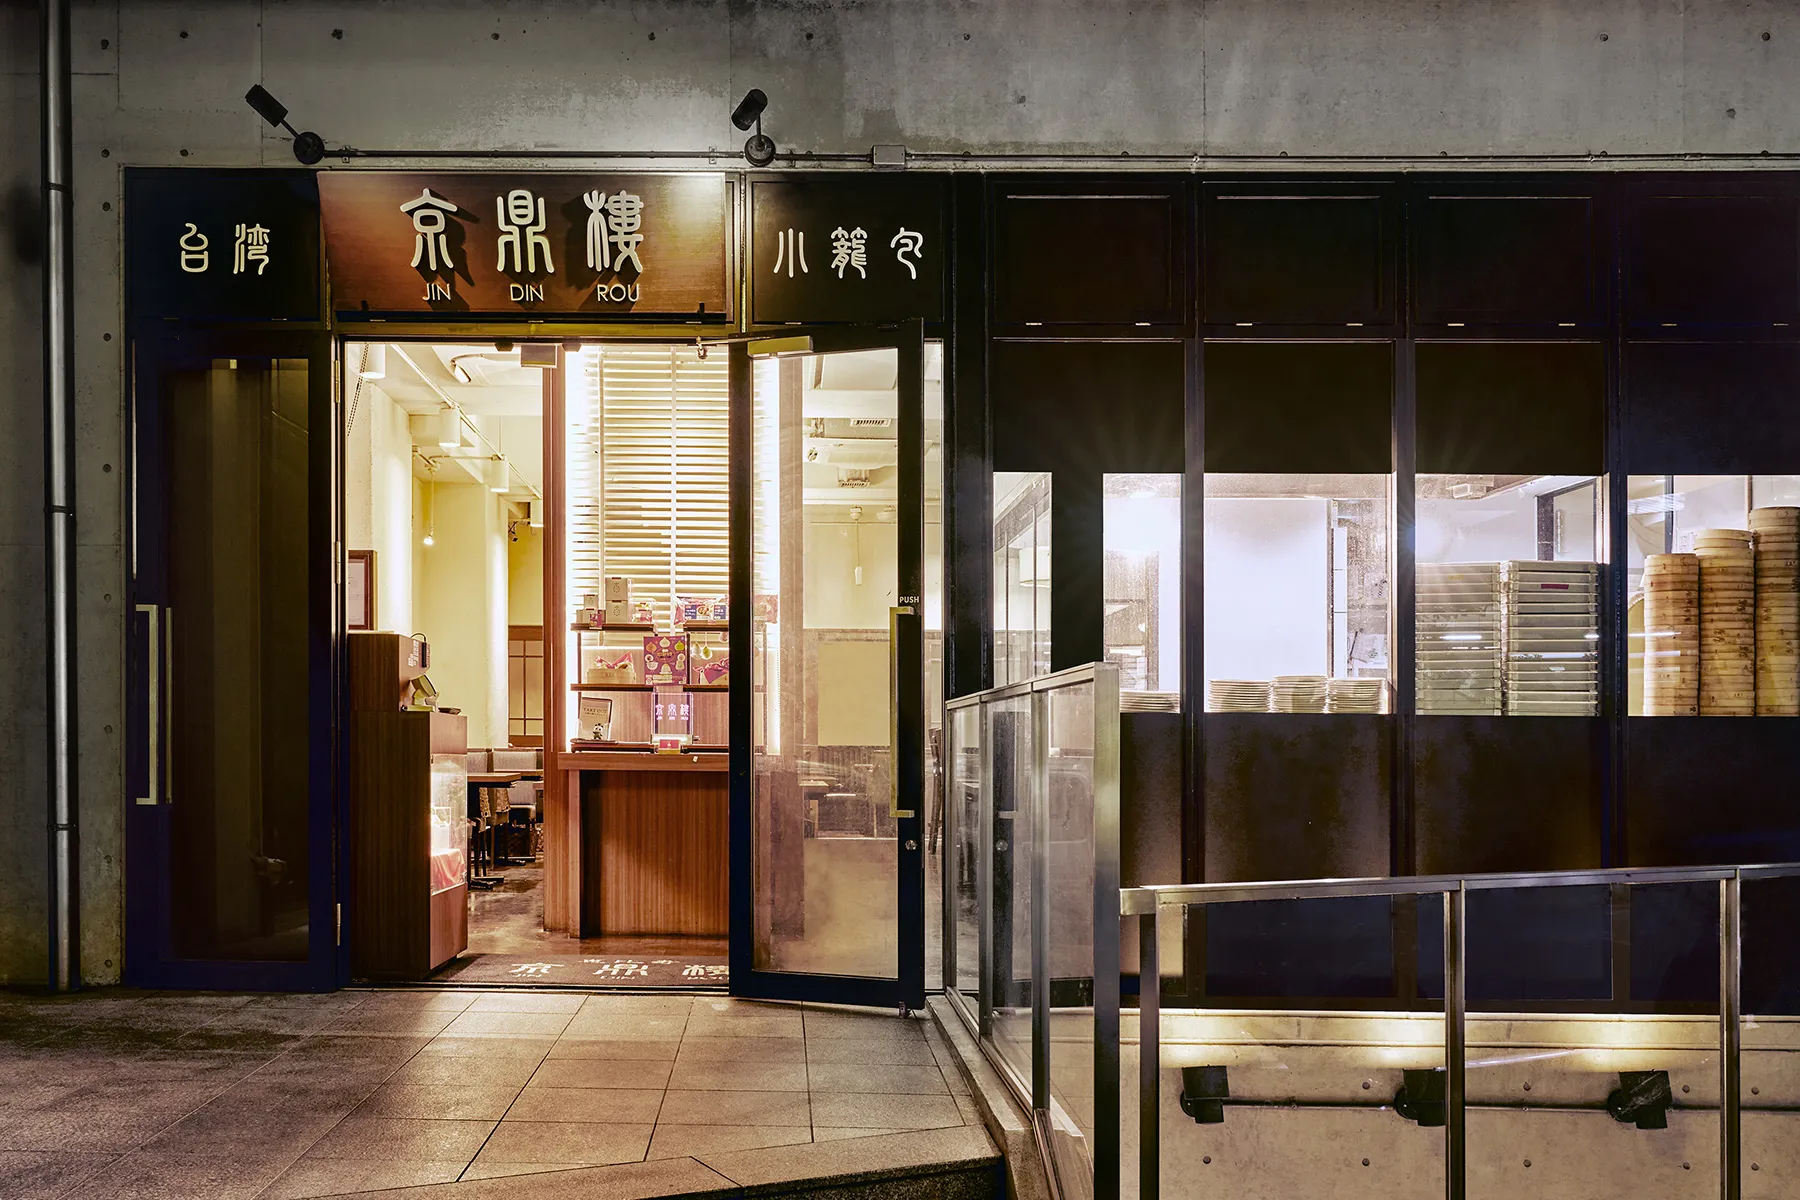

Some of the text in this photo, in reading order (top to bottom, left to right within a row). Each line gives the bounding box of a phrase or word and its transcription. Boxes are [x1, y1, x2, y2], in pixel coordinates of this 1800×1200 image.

[179, 222, 271, 276] 台湾
[400, 188, 645, 274] 京鼎樓
[773, 226, 925, 280] 小籠包
[422, 283, 640, 302] JIN DIN ROU
[899, 596, 920, 604] PUSH
